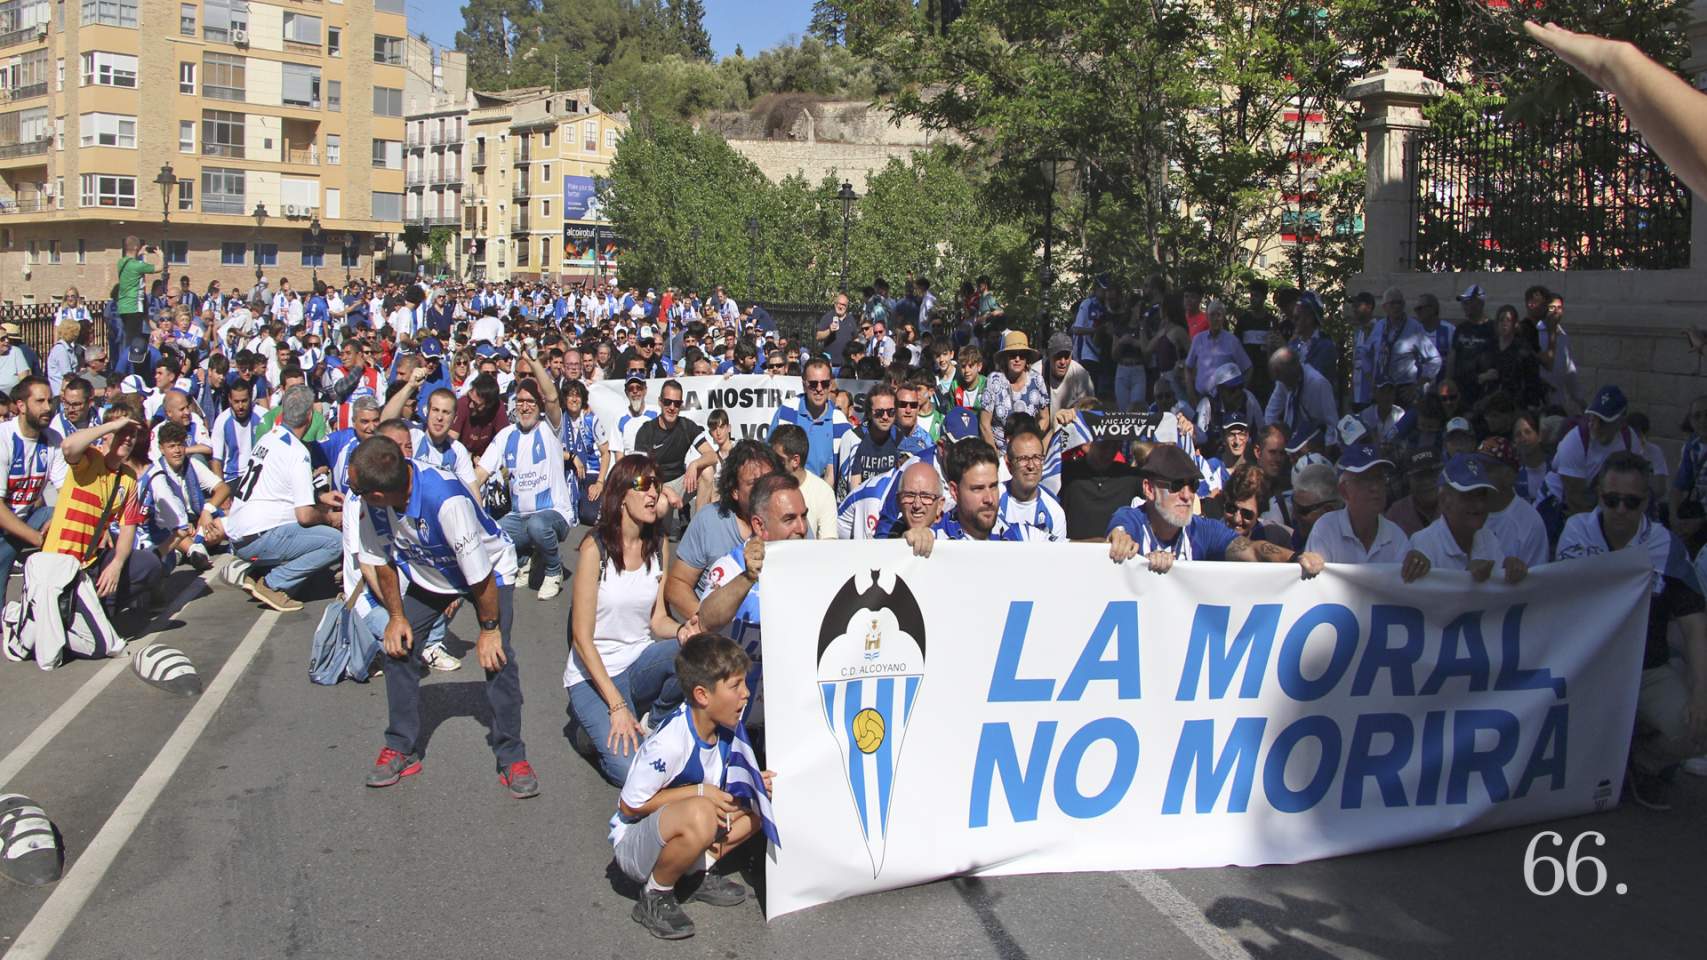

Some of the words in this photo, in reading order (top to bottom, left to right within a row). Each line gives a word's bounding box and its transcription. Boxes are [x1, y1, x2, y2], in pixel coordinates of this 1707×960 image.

[679, 391, 702, 411] A
[860, 663, 906, 673] ALCOYANO
[988, 600, 1141, 703] LA
[1176, 601, 1566, 702] MORAL
[969, 717, 1140, 828] NO
[1161, 704, 1569, 815] MORIRA
